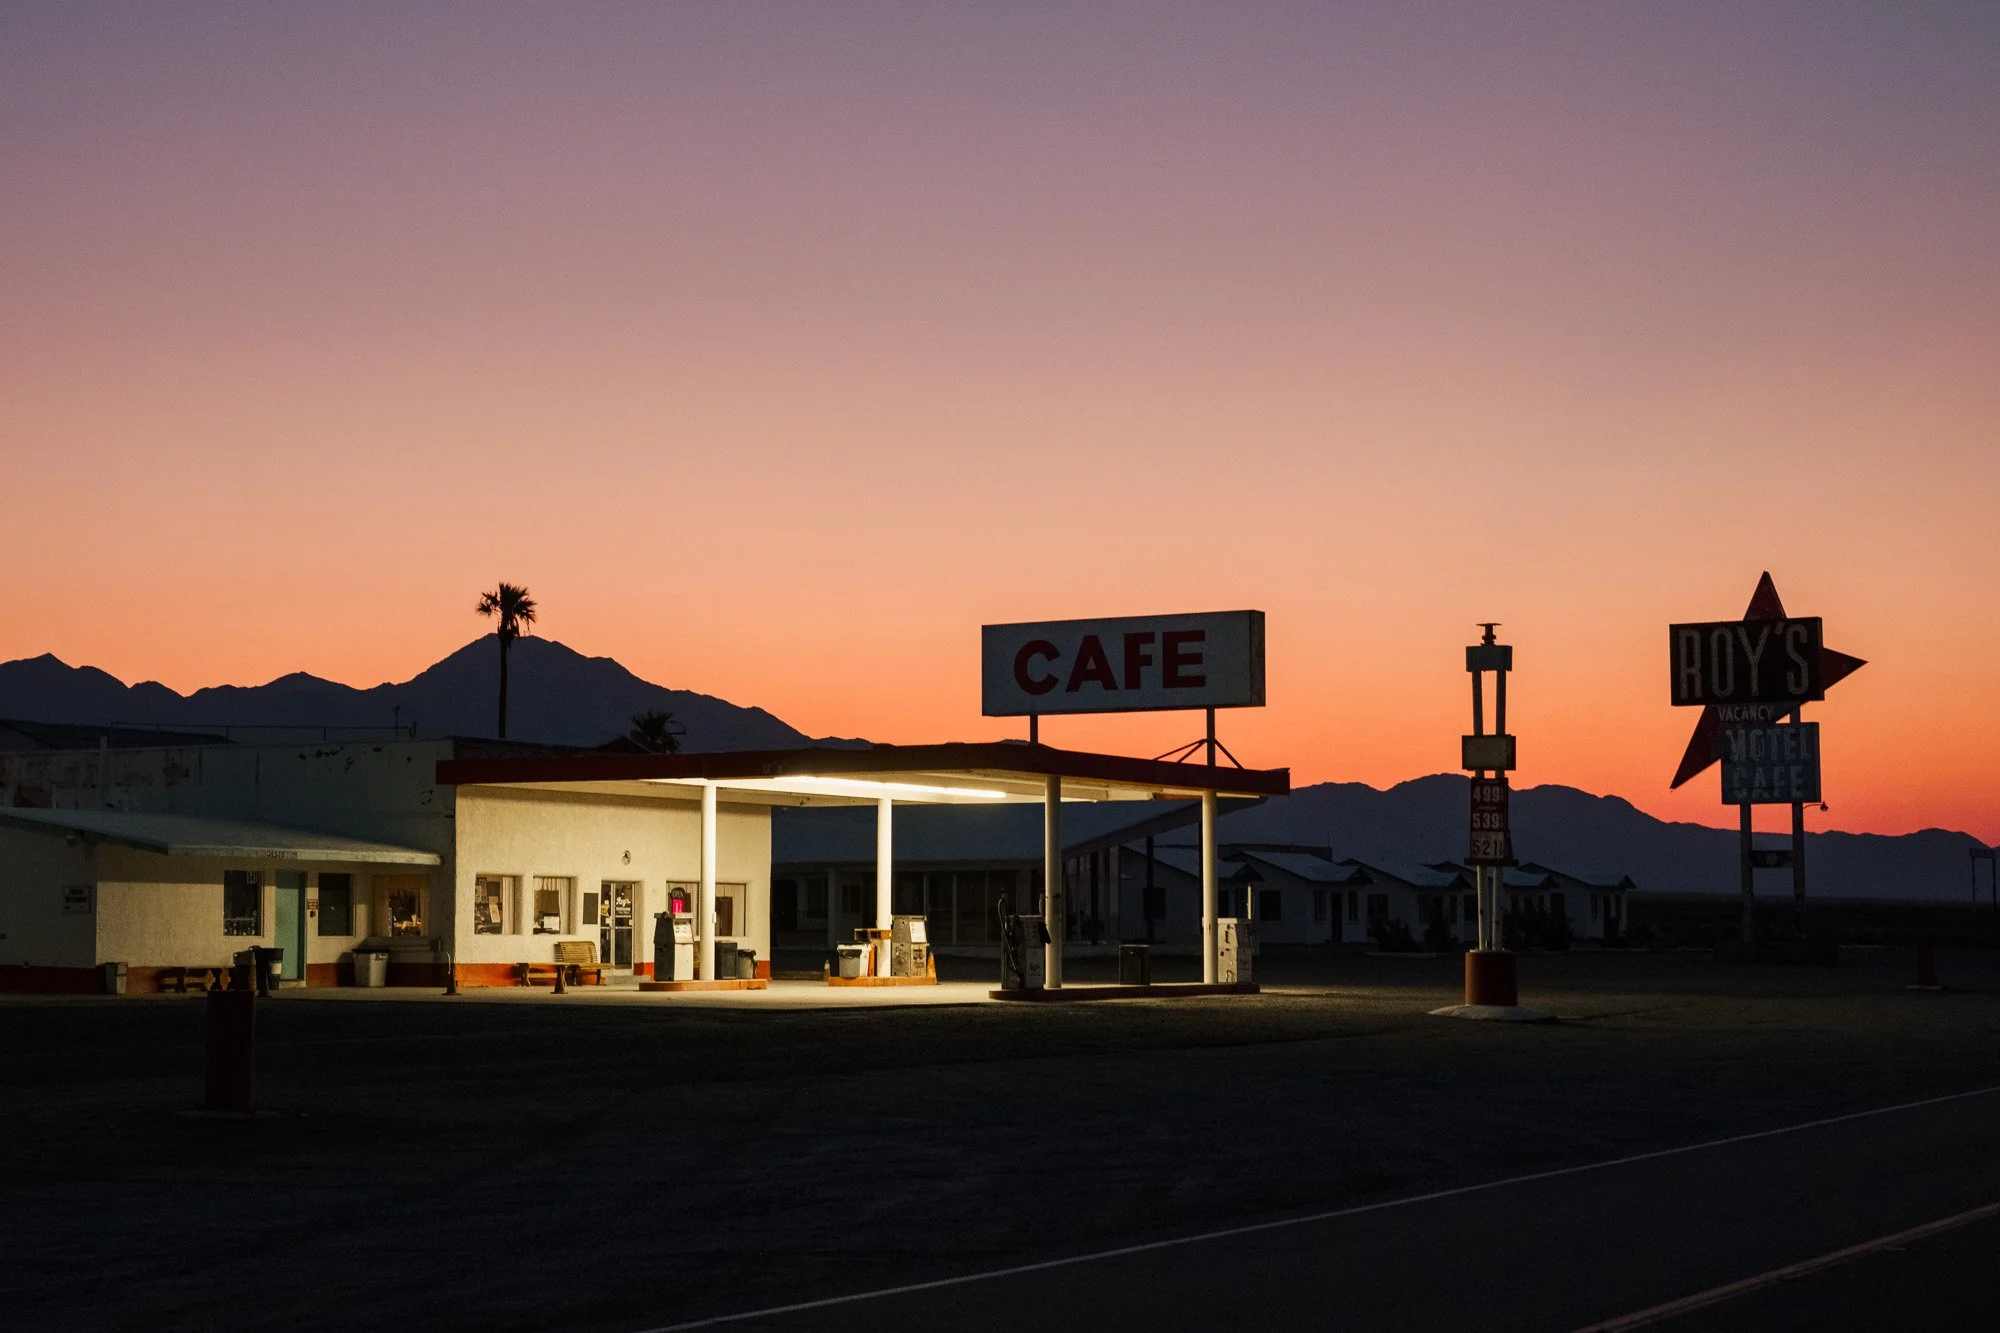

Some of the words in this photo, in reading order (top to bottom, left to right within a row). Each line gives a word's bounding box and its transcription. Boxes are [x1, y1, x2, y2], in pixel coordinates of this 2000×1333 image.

[1013, 630, 1207, 695] CAFE
[1678, 621, 1809, 700] ROY'S
[1717, 704, 1774, 722] VACANCY
[1726, 727, 1812, 762] MOTEL
[1732, 765, 1806, 799] CAFE
